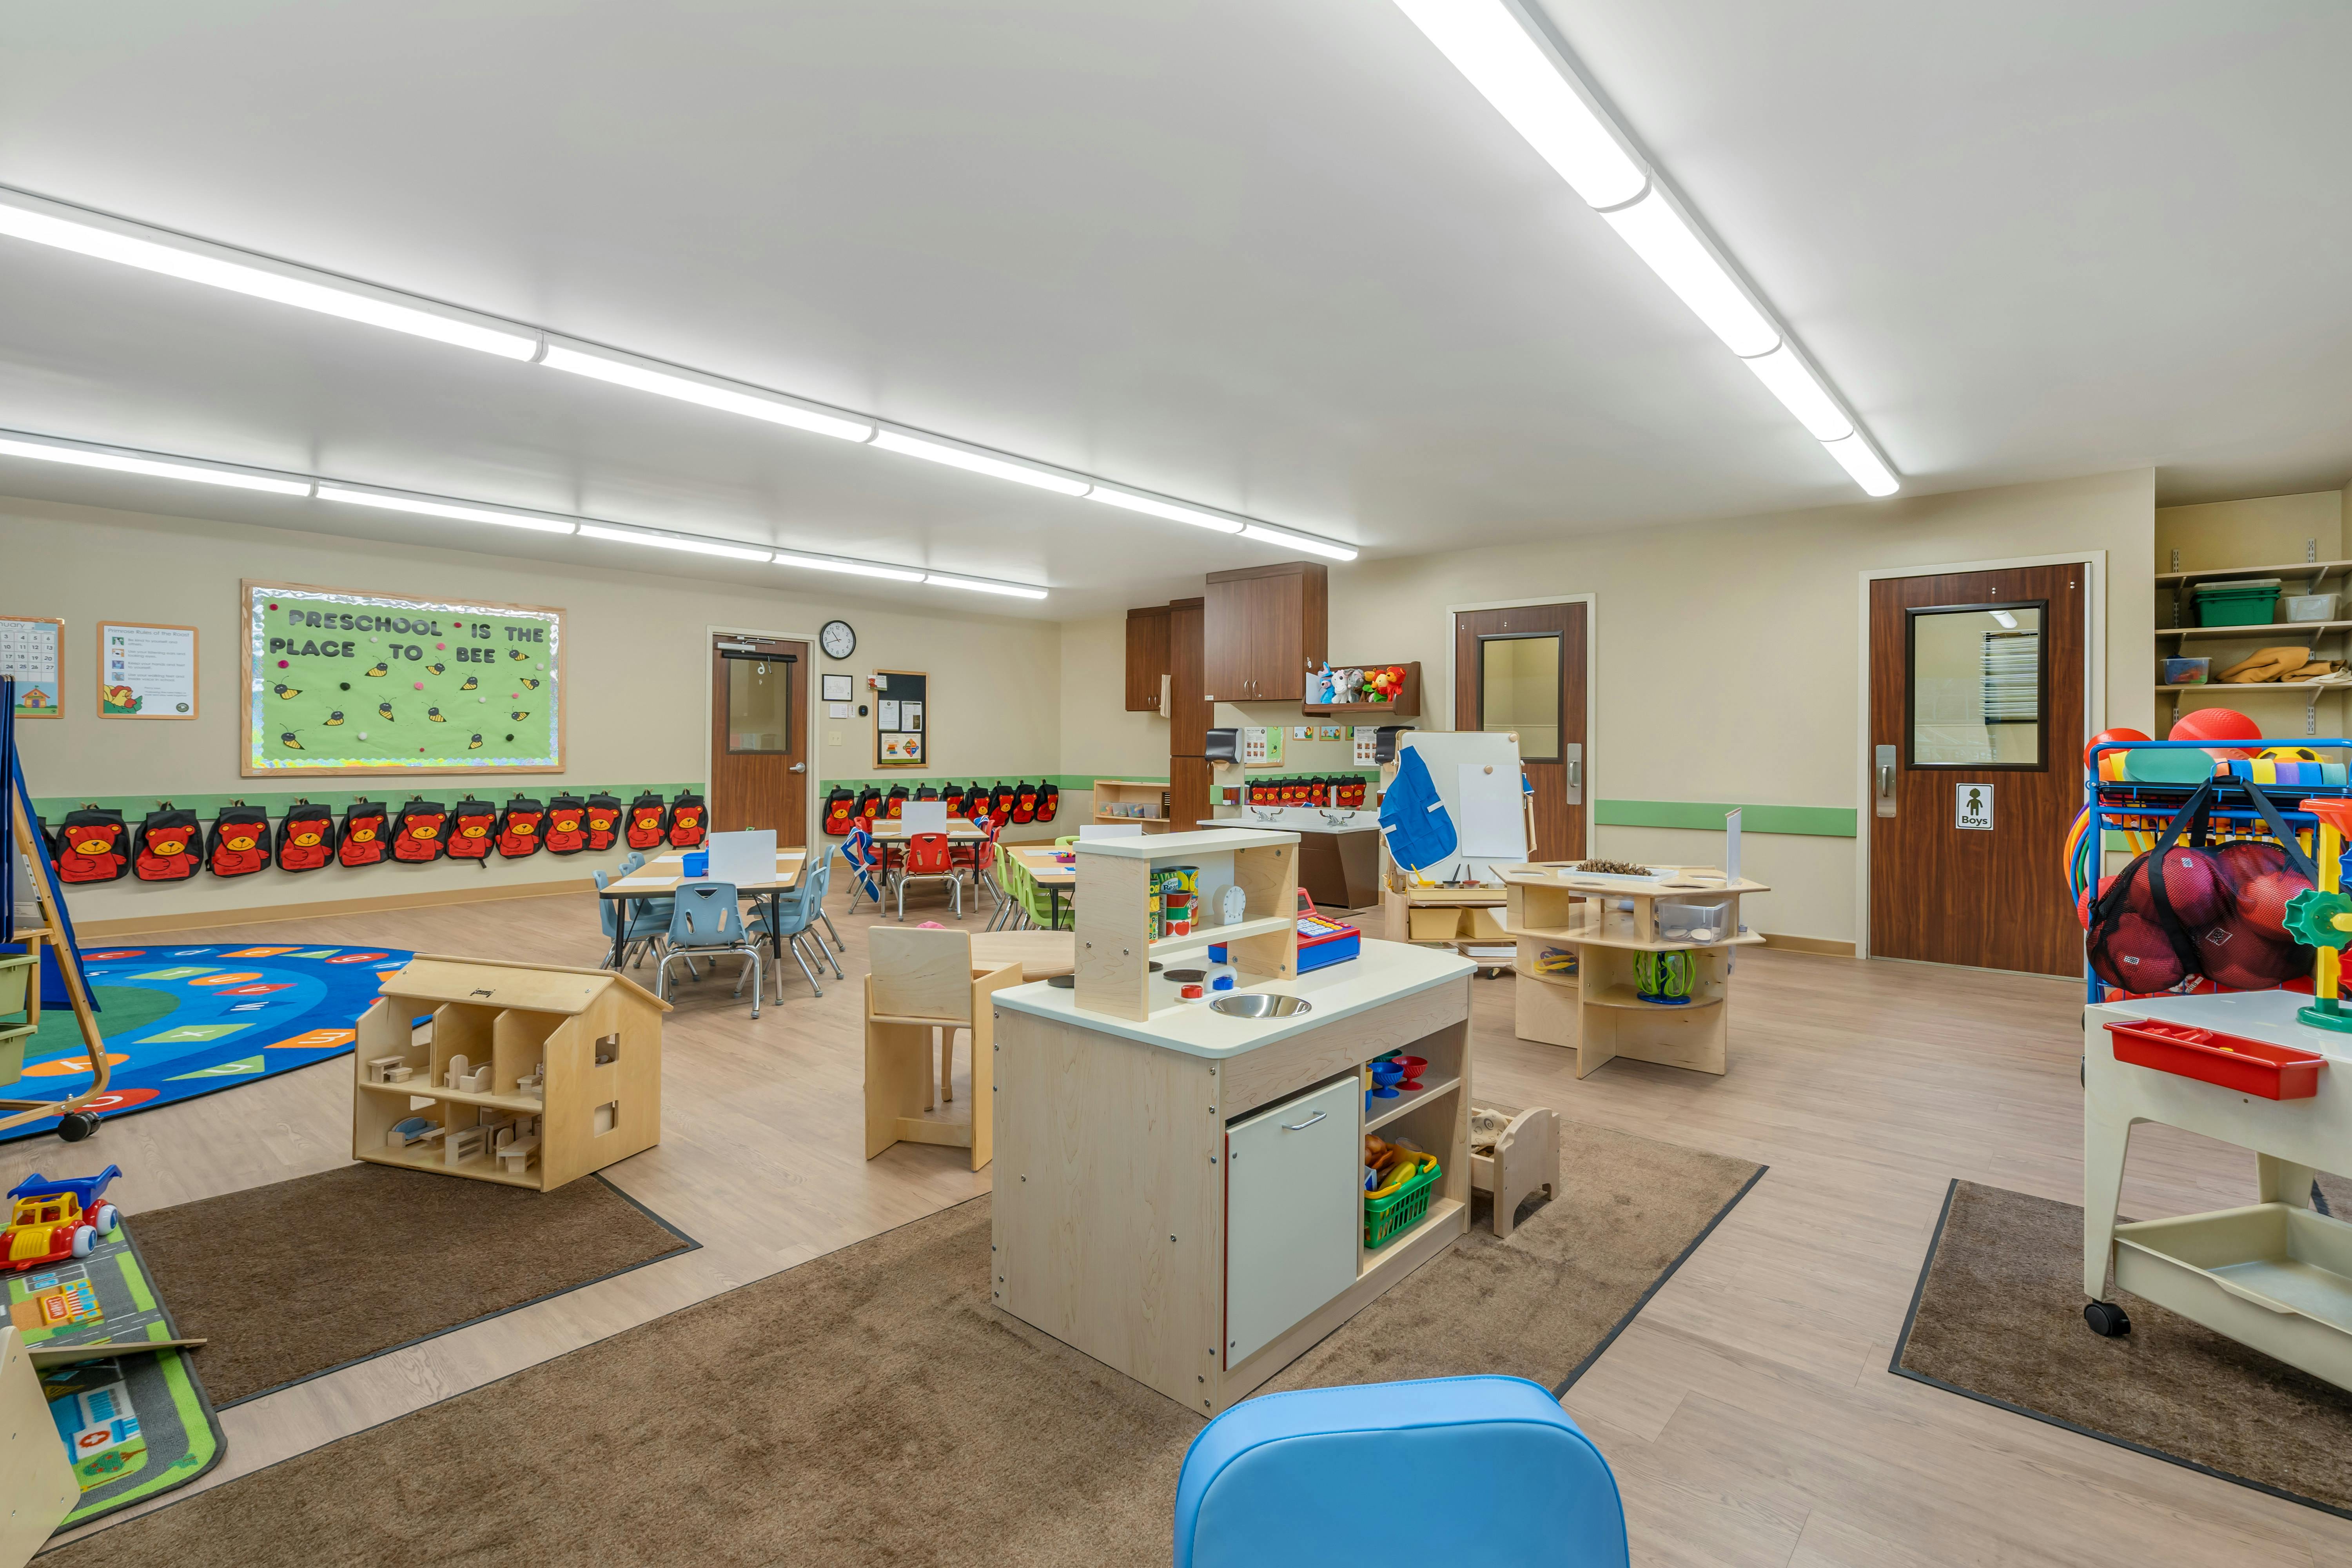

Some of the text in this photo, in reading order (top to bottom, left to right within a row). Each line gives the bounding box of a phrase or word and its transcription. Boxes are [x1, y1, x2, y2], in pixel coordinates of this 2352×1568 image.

[289, 610, 544, 642] PRESCHOOL IS THE
[270, 637, 495, 663] PLACE TO BEE
[1962, 816, 1988, 826] Boys
[230, 1002, 269, 1011] w
[298, 1033, 352, 1044] m
[48, 1297, 64, 1317] MARKET
